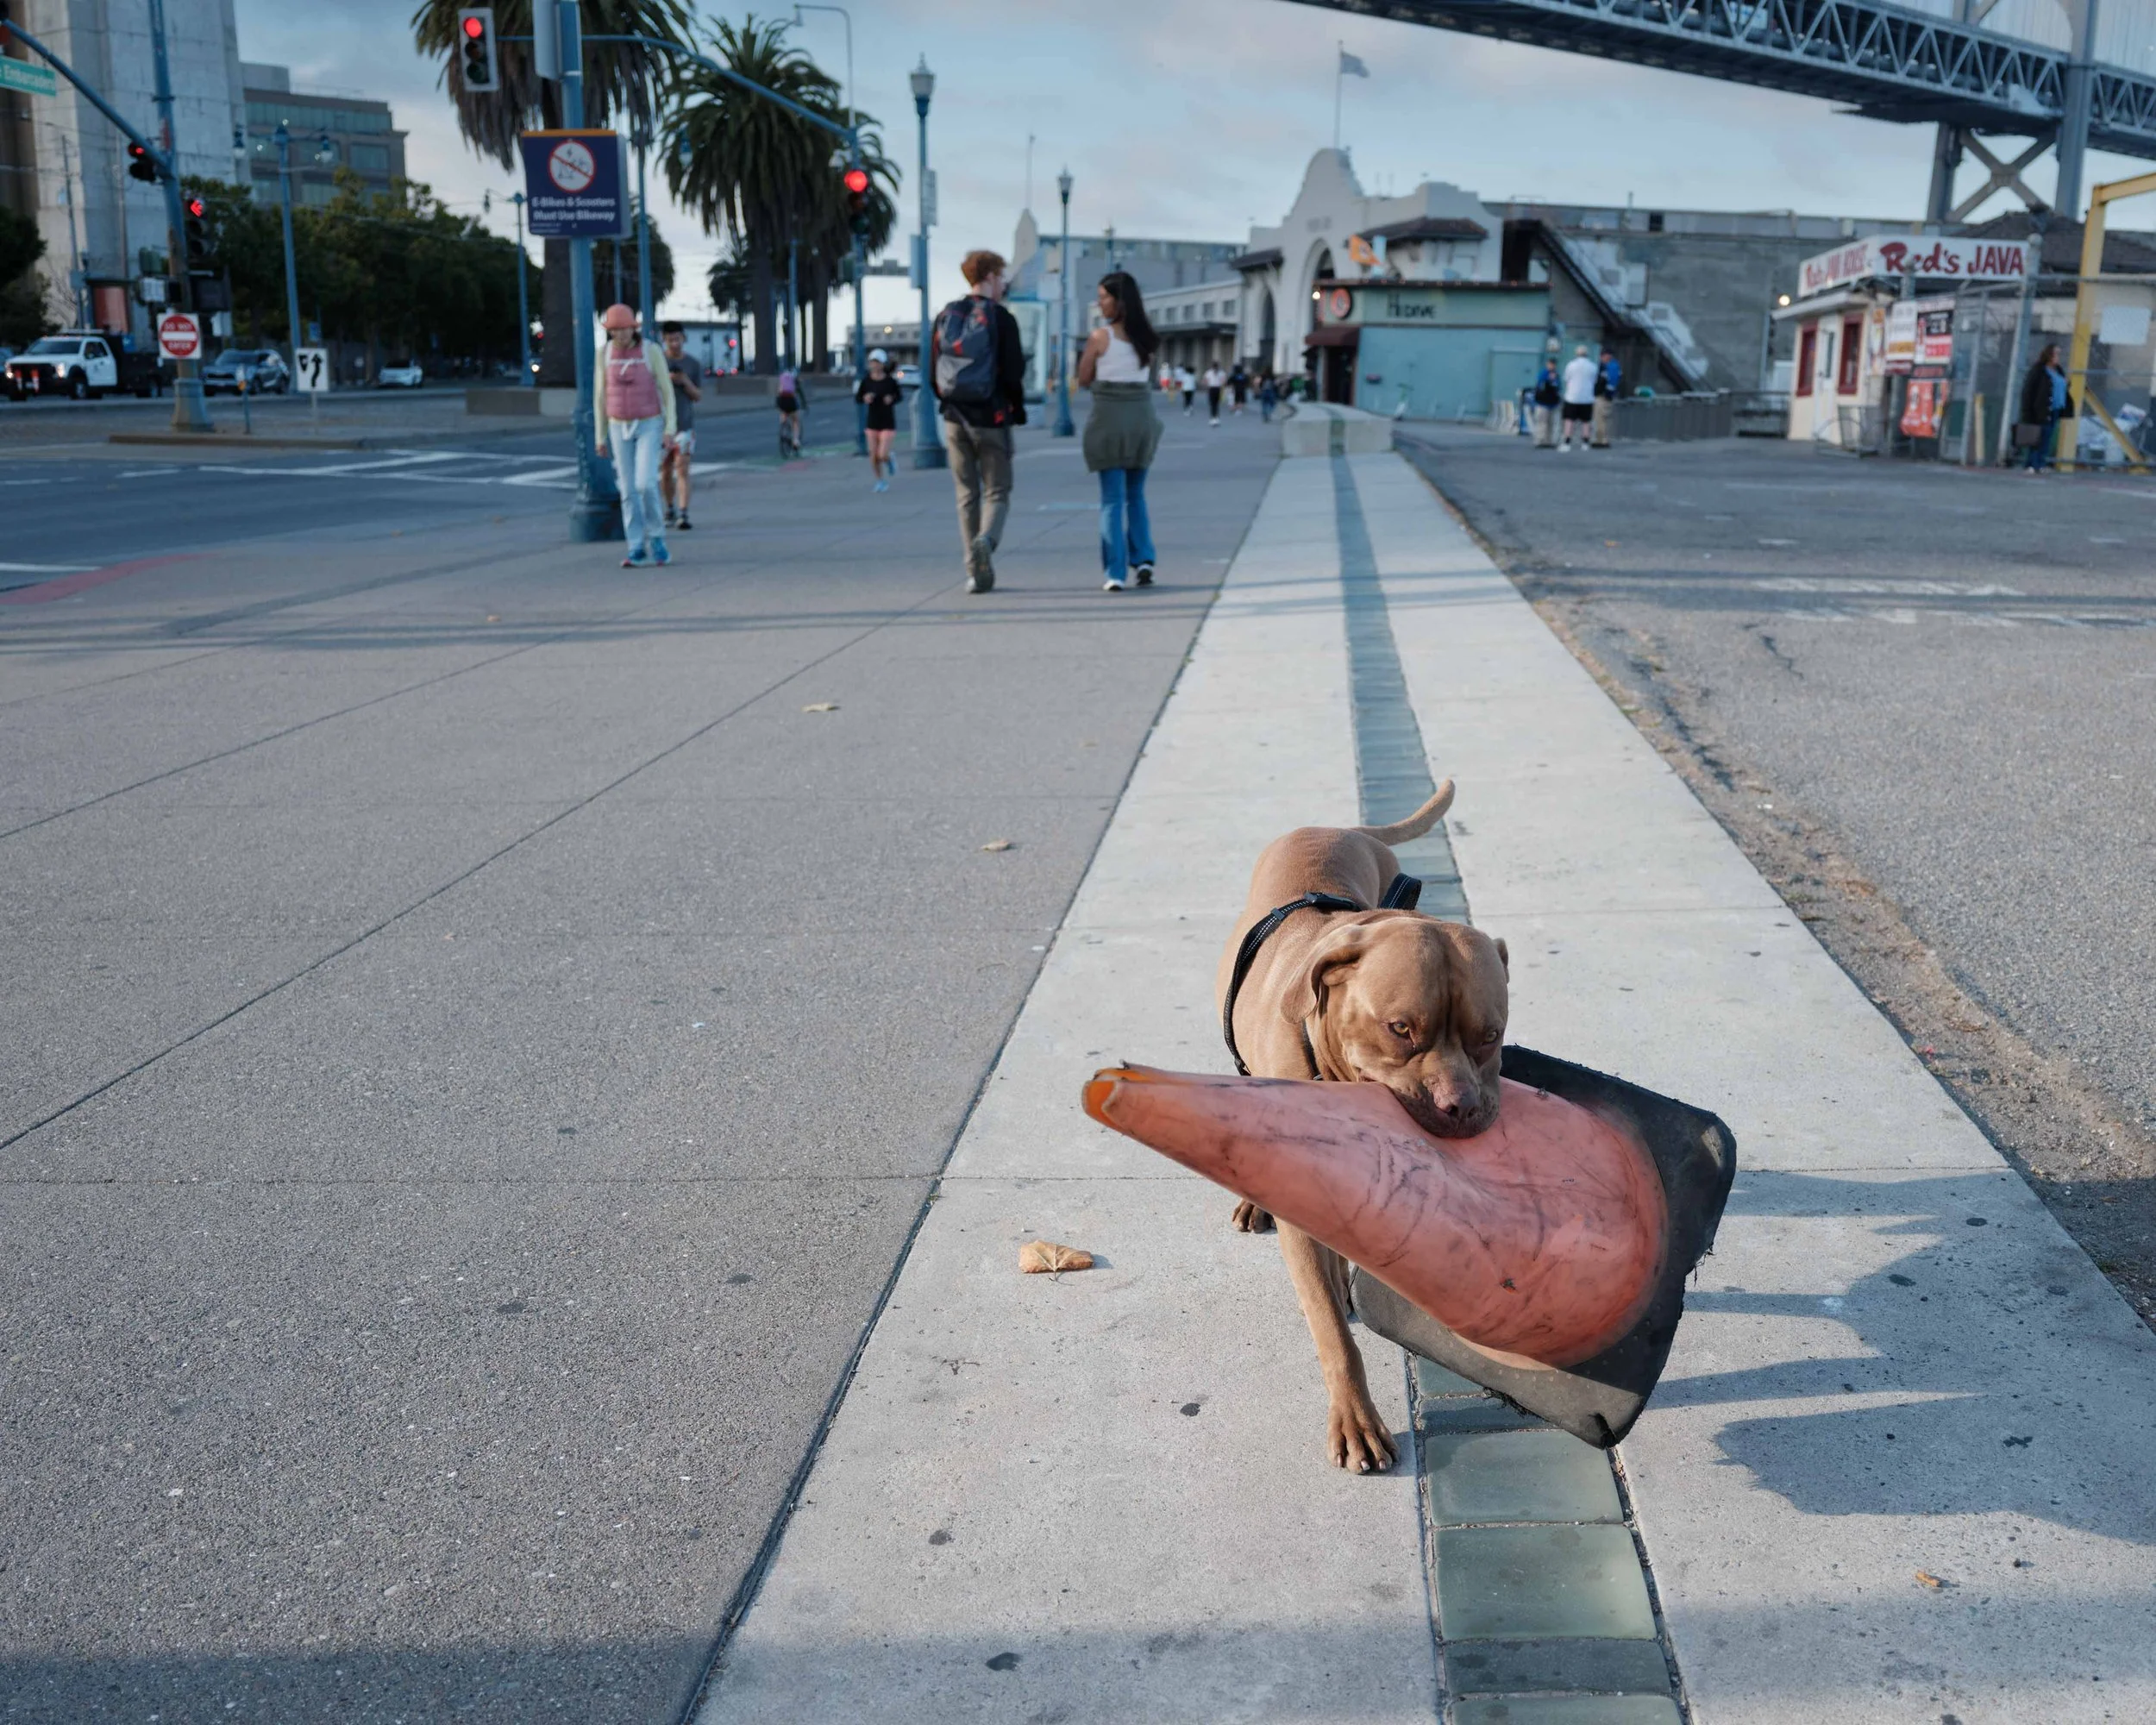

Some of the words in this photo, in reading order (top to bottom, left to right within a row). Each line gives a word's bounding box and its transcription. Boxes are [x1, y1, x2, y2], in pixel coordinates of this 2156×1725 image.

[575, 197, 615, 207] Scooters
[576, 210, 615, 222] Bikeway
[1966, 245, 2024, 275] JAVA
